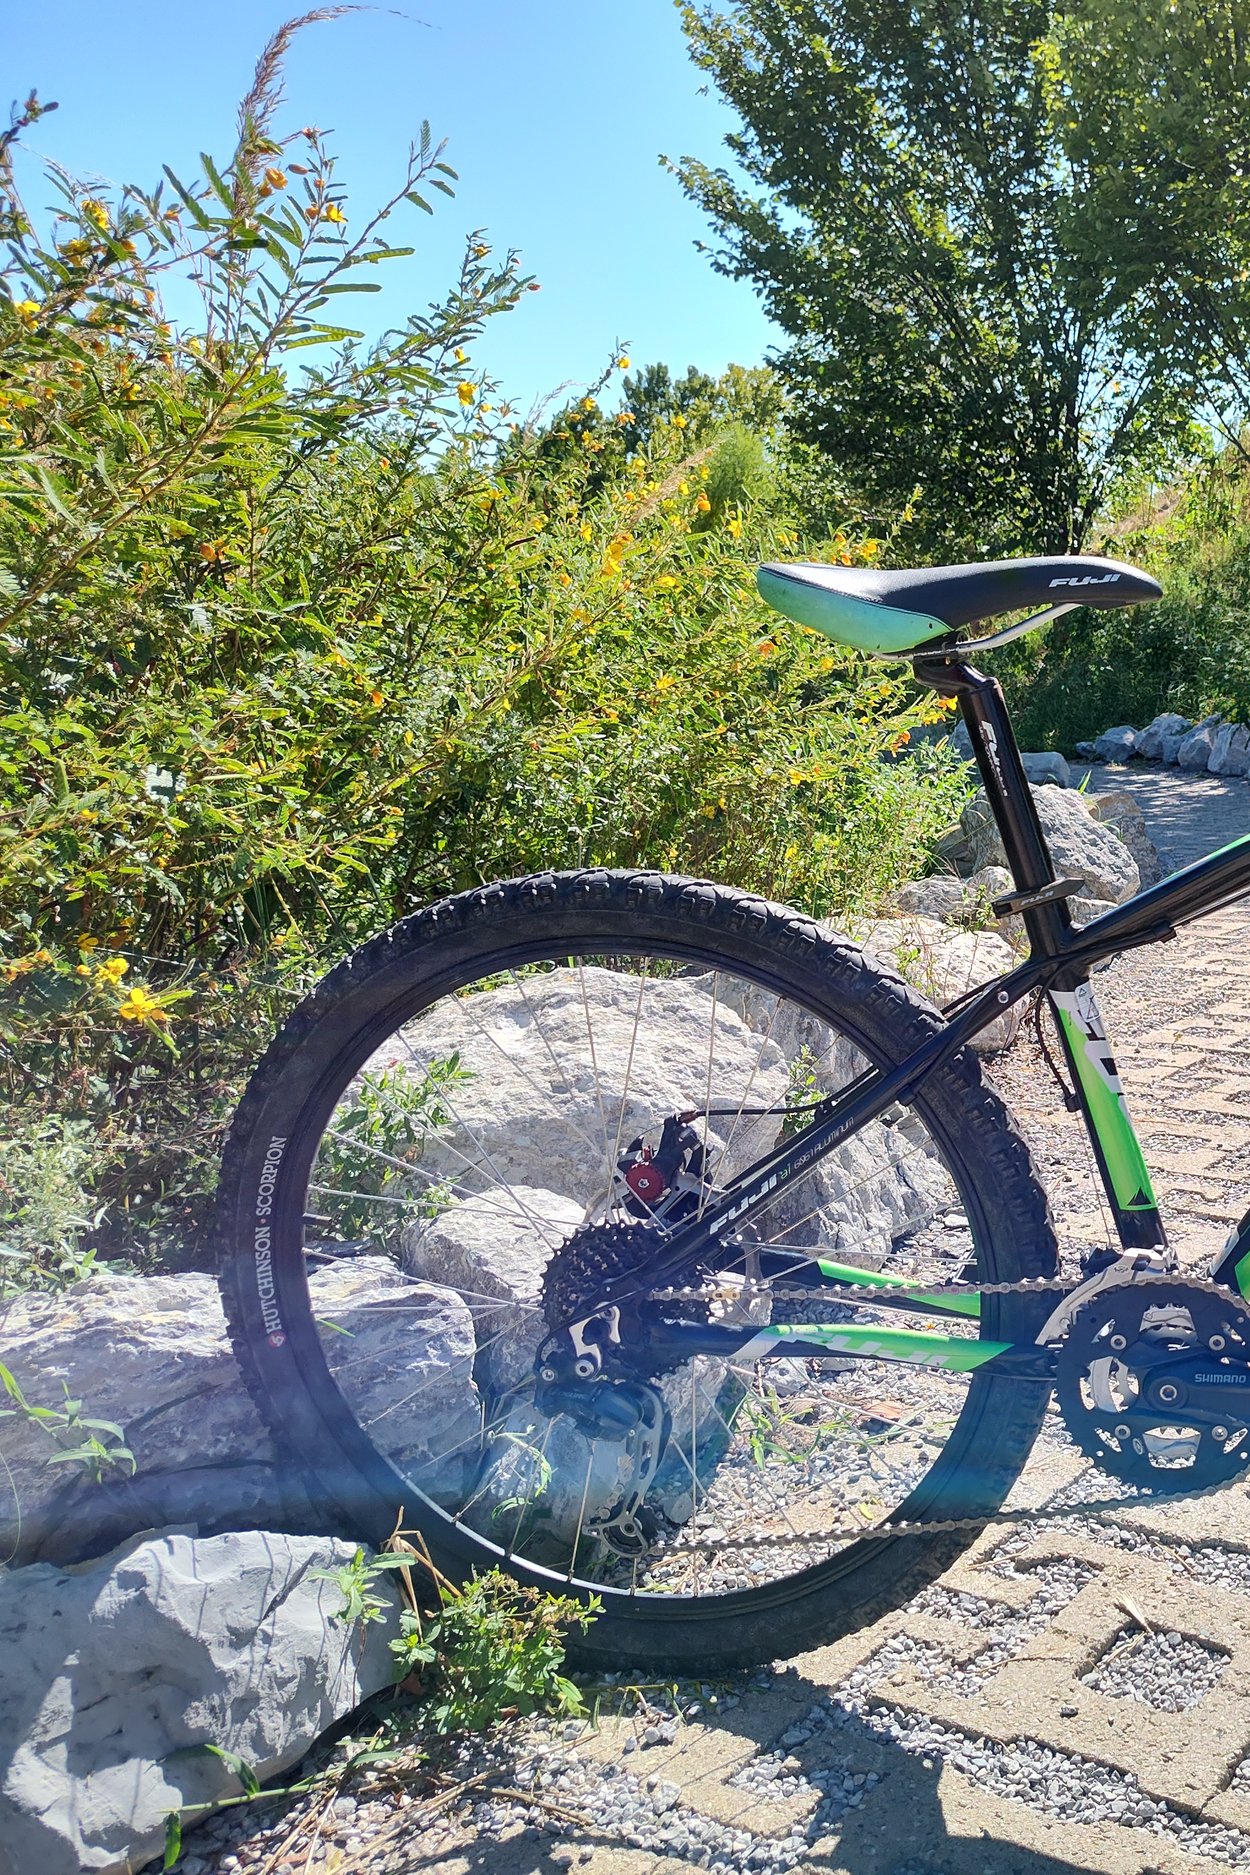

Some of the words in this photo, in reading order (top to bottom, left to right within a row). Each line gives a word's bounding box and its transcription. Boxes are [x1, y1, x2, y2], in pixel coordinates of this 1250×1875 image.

[1048, 573, 1121, 588] FUJI
[256, 1135, 288, 1216] SCORPION
[709, 1173, 777, 1235] FUJI
[254, 1226, 282, 1334] HUTCHINSON
[1194, 1373, 1247, 1384] SHIMANO
